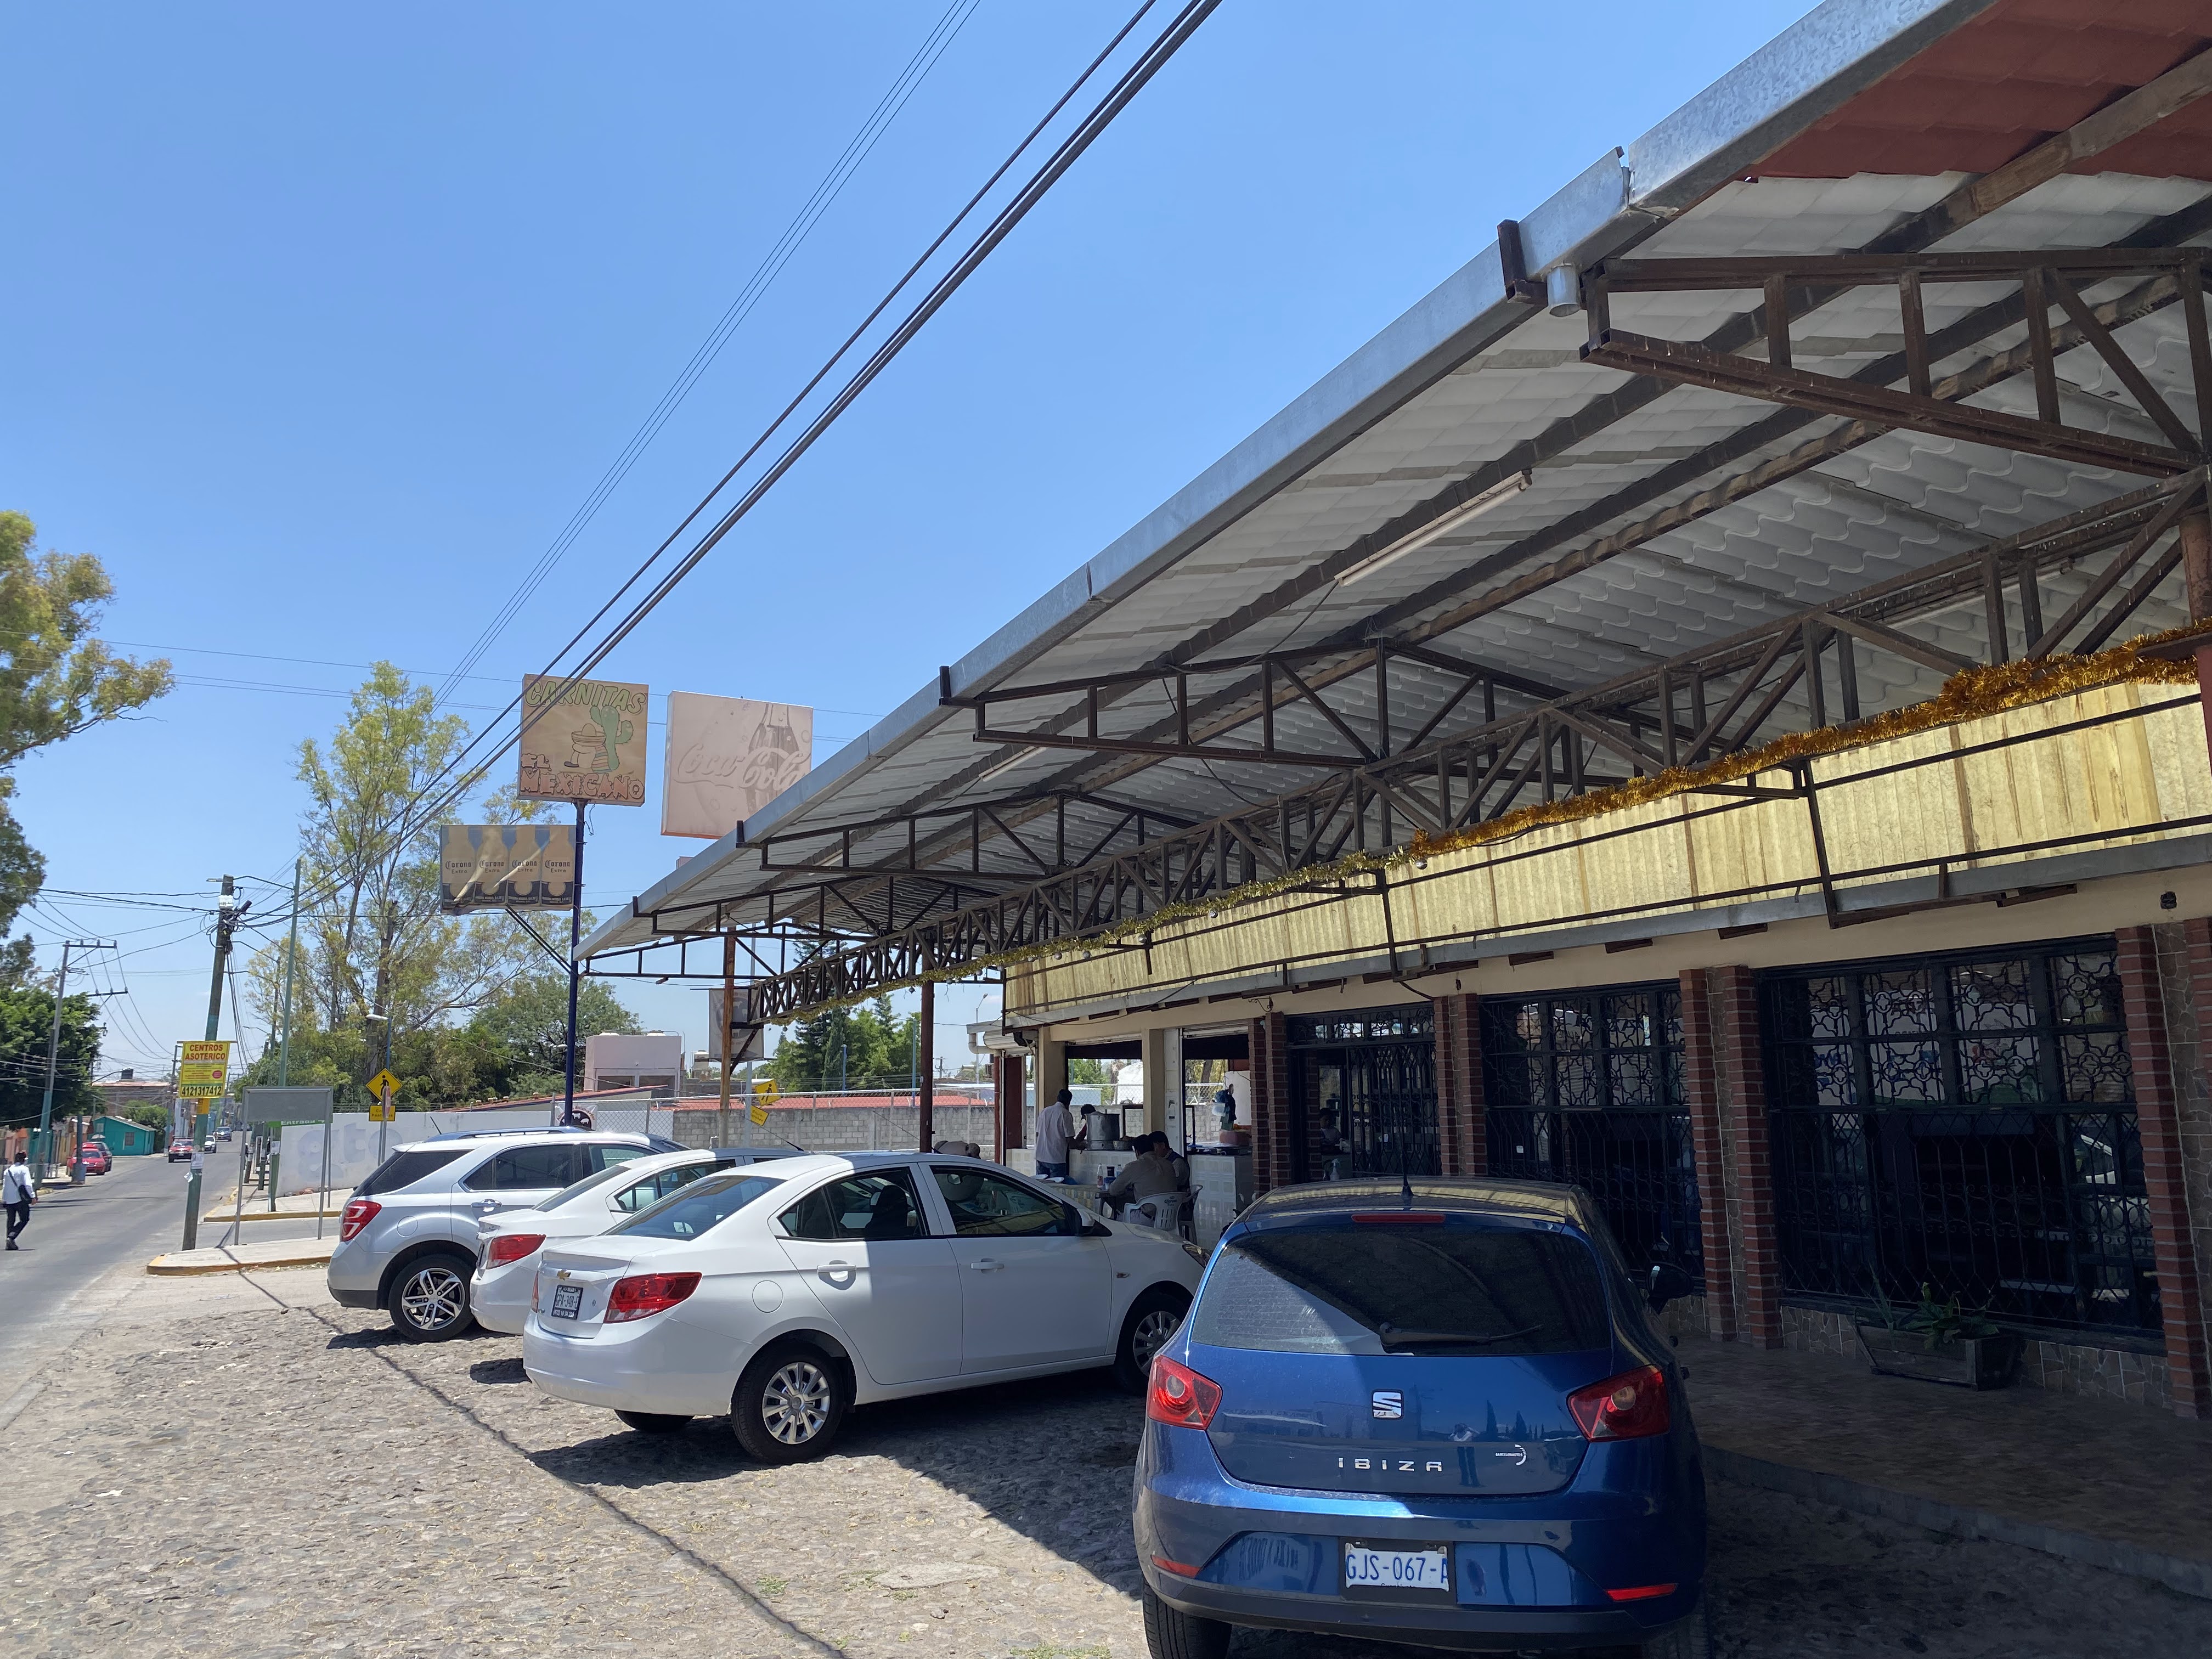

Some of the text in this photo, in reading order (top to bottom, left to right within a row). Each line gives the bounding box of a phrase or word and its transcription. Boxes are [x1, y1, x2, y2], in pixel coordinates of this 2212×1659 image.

[526, 681, 646, 714] CARNITAS
[521, 753, 550, 769] EL
[520, 769, 645, 799] MEXICANO
[445, 860, 471, 870] Corona
[479, 860, 504, 868] Corona
[545, 860, 571, 868] Corona
[182, 1086, 222, 1096] 4121317412
[1338, 1457, 1442, 1472] IBIZA
